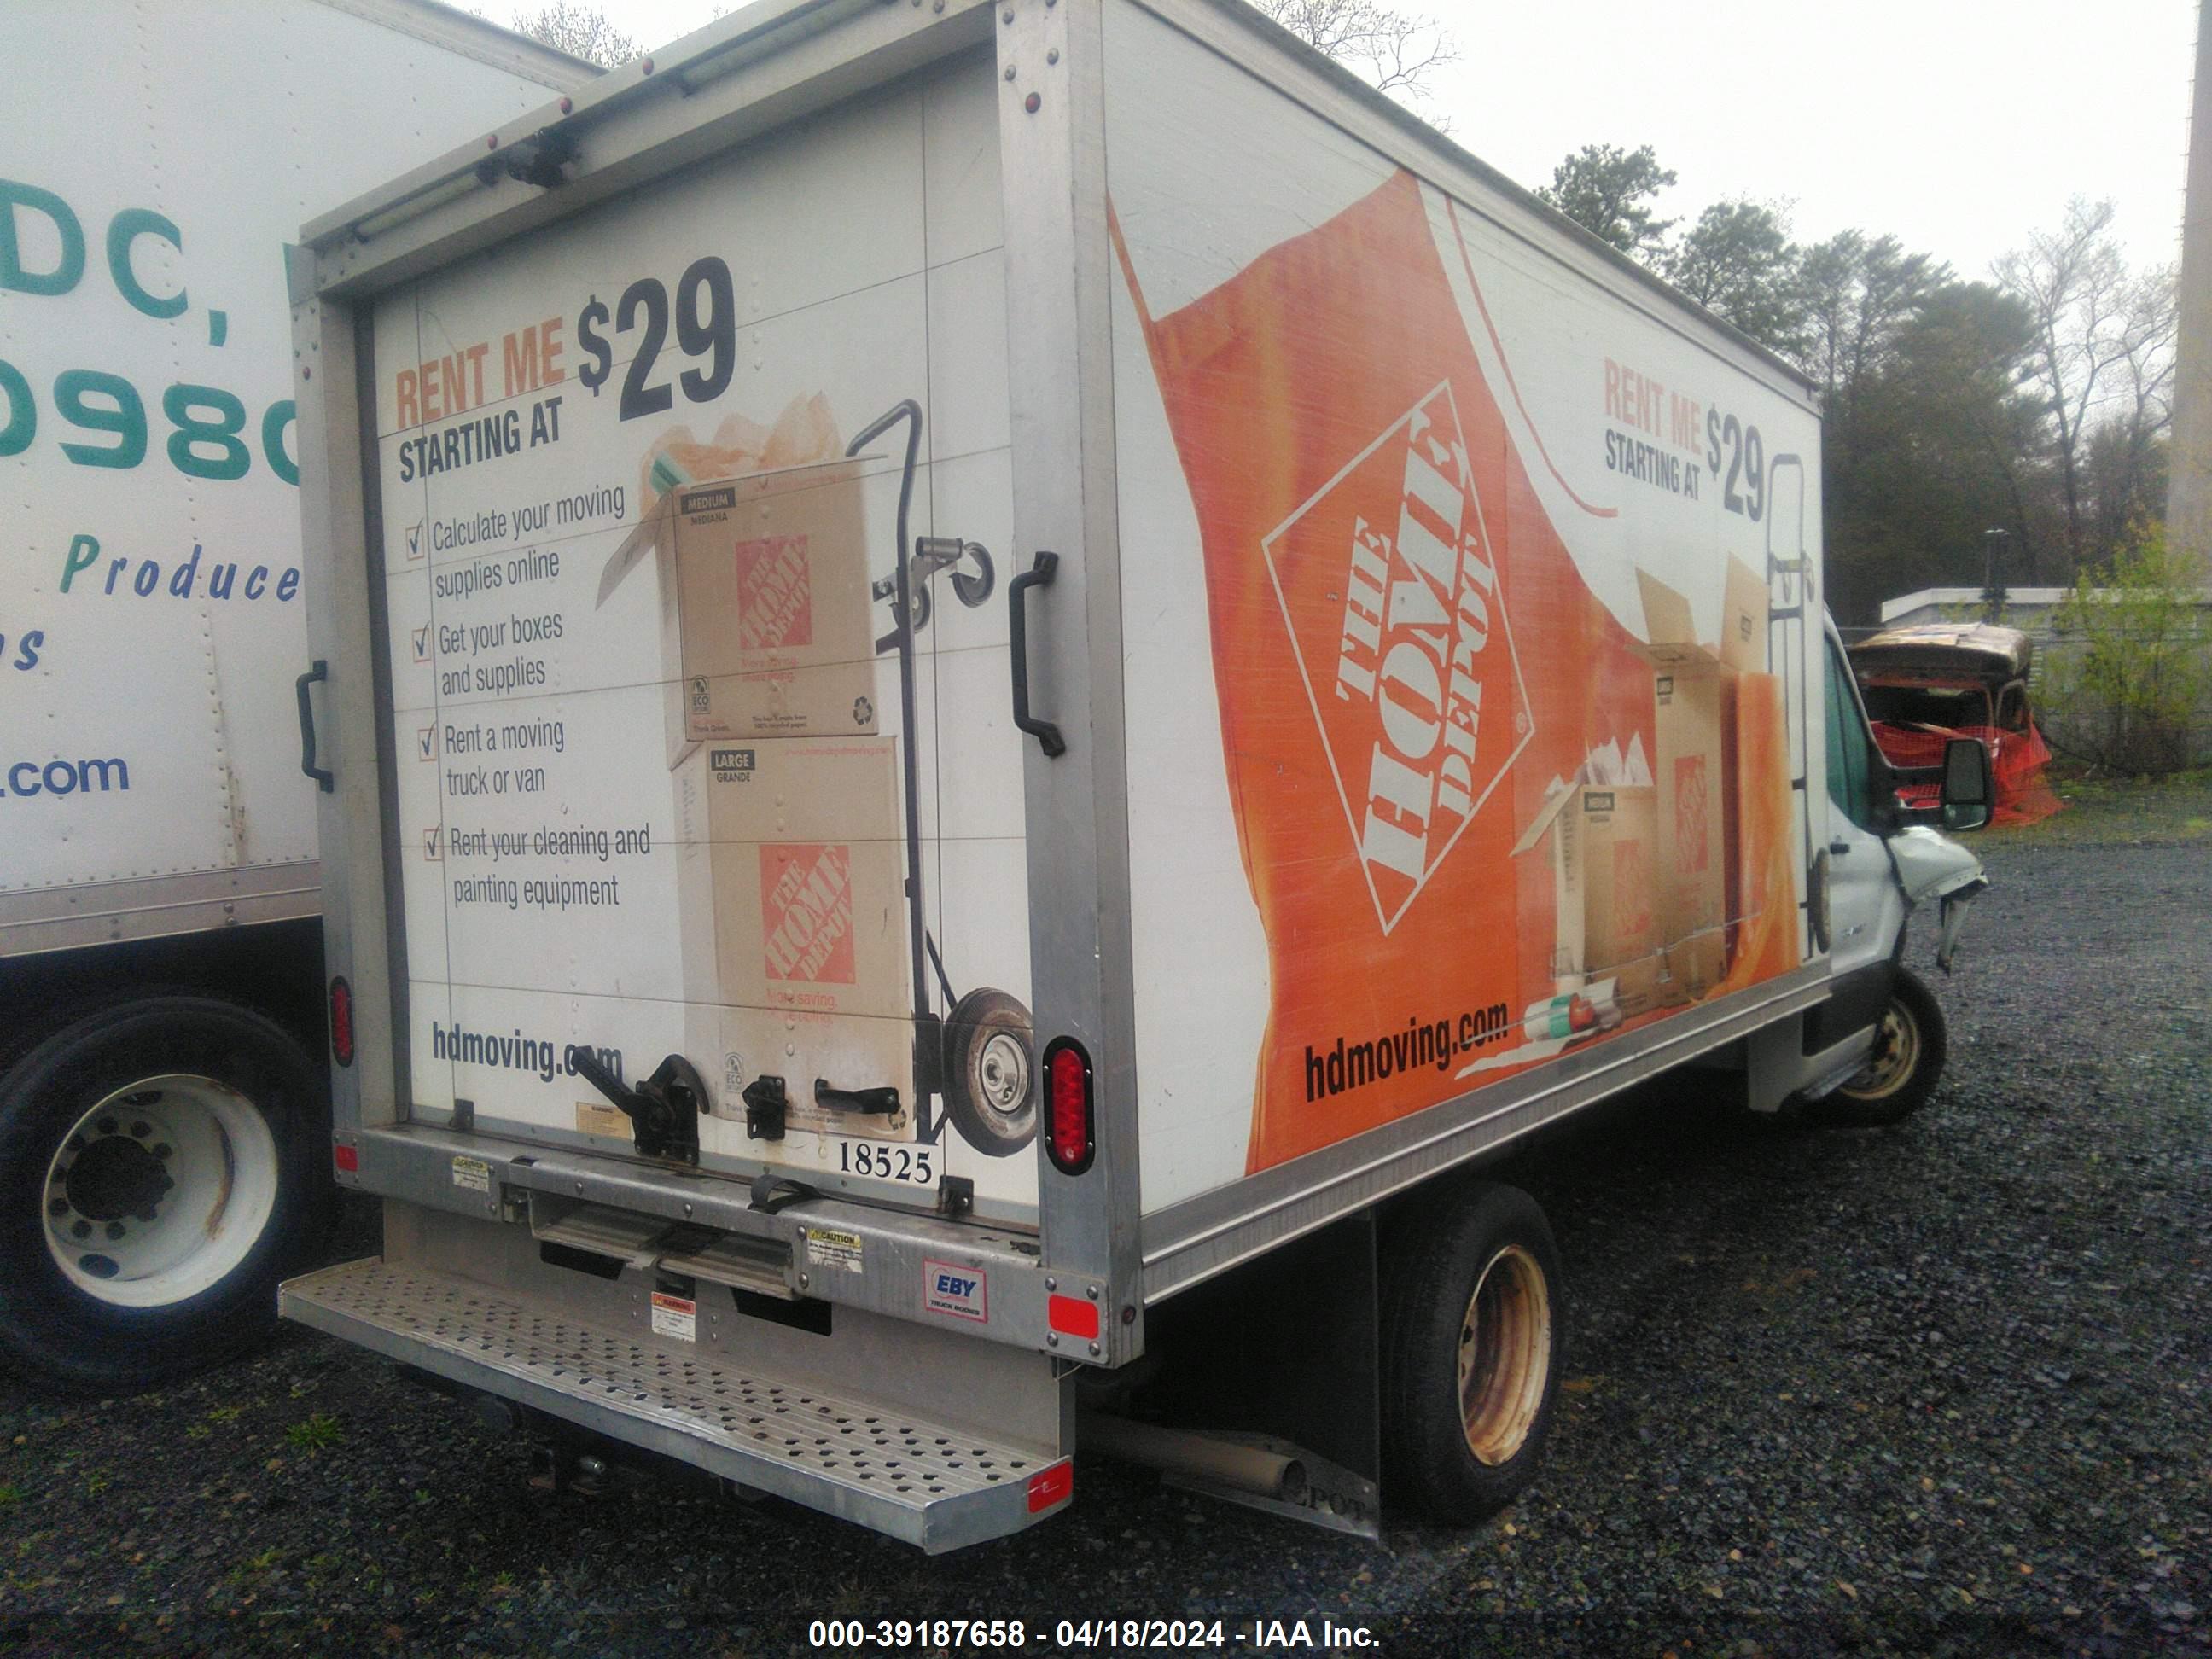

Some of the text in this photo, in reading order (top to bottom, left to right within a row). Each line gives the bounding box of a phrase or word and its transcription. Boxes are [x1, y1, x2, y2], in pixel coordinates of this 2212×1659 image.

[577, 256, 736, 422] $29
[396, 317, 566, 431] RENT ME
[1604, 357, 1701, 455] RENT ME
[399, 396, 562, 483] STARTING AT
[1605, 428, 1700, 500] STARTING AT
[1707, 402, 1764, 522] $29
[433, 484, 625, 551] Calculate your moving
[687, 493, 730, 511] MEDIUM
[690, 512, 728, 526] MEDIANA
[59, 533, 300, 602] Produce
[435, 549, 560, 601] supplies online
[1336, 515, 1391, 702] THE
[439, 614, 563, 656] Get your boxes
[1363, 408, 1467, 885] HOME
[442, 656, 546, 696] and supplies
[1438, 533, 1494, 822] DEPOT
[445, 717, 564, 754] Rent a moving
[446, 765, 545, 796] truck or van
[715, 754, 749, 767] LARGE
[717, 771, 751, 783] GRANDE
[451, 822, 651, 863] Rent your cleaning and
[453, 873, 620, 910] painting equipment
[433, 1021, 622, 1084] hdmoving.cm
[1305, 1002, 1508, 1103] hdmoving.com
[726, 1074, 742, 1085] ECO
[840, 1141, 932, 1184] 18525
[821, 1231, 854, 1244] CAUTION
[930, 1300, 952, 1309] TRUCK
[937, 1274, 976, 1298] EBY
